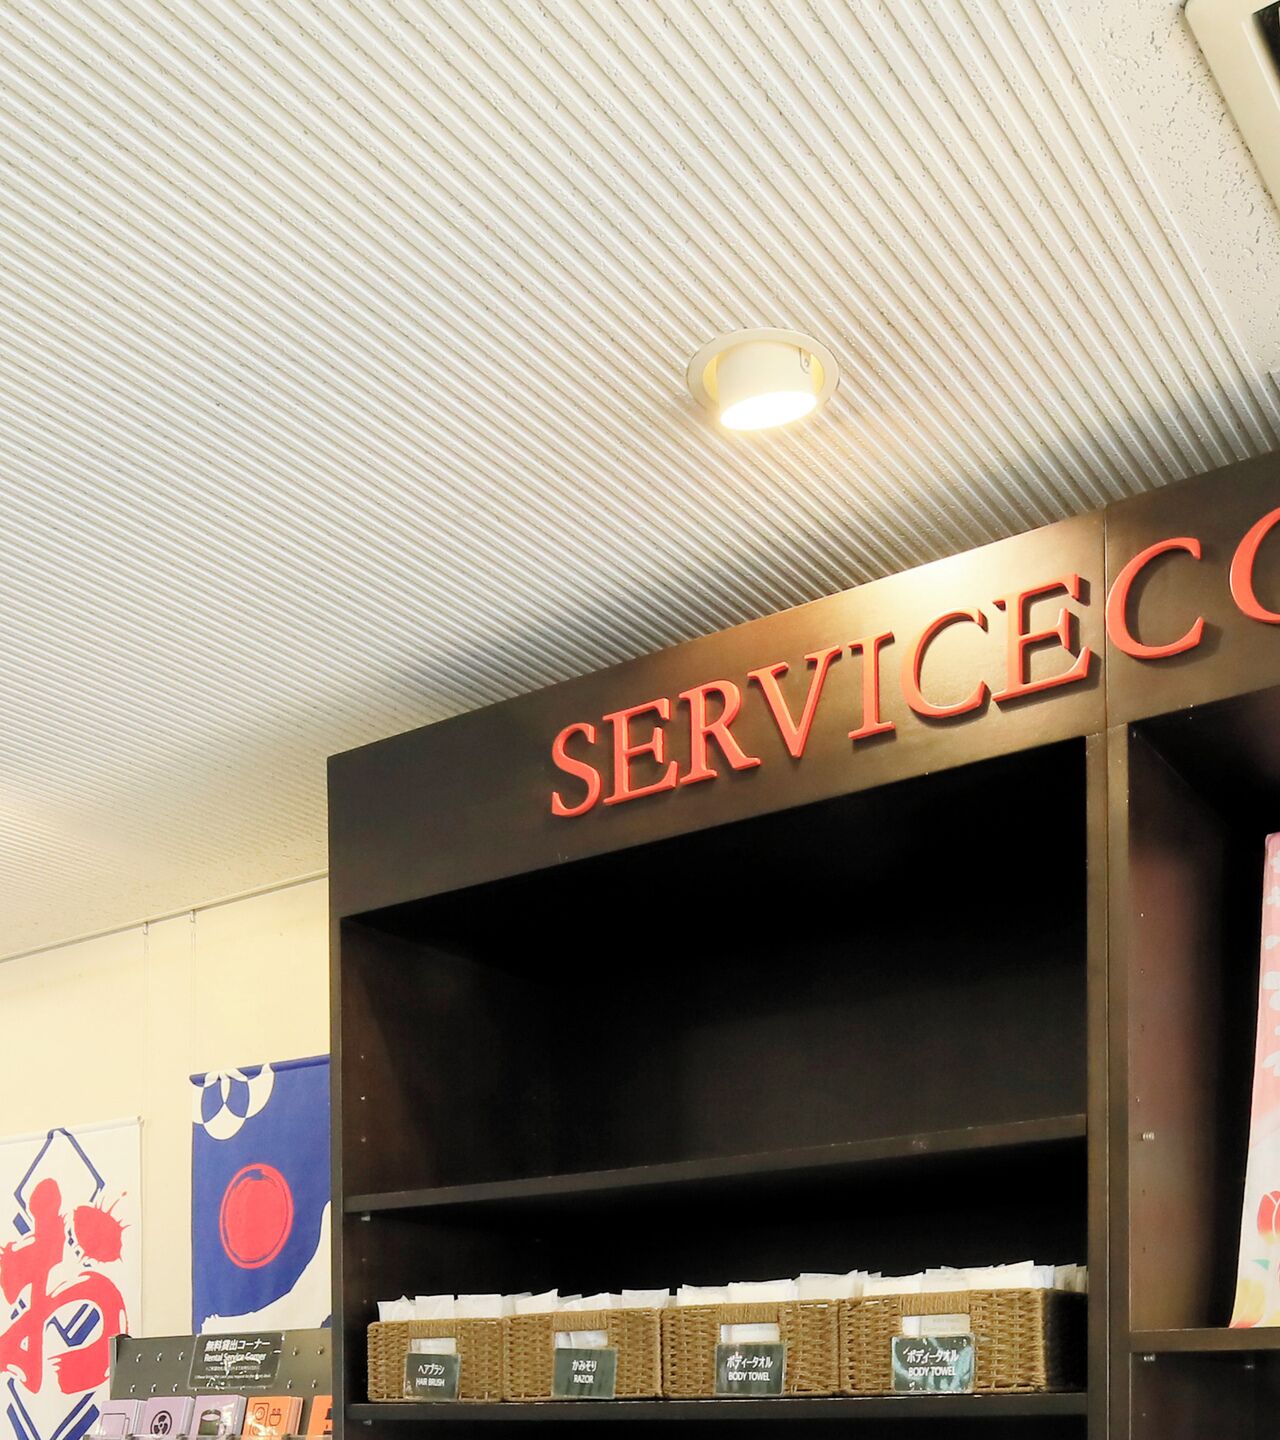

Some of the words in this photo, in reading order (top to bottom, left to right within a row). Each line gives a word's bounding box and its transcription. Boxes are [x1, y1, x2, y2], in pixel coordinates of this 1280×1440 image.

[551, 570, 1102, 817] SERVICE
[205, 1338, 270, 1352] 無料貸出コーナー
[204, 1354, 223, 1362] Rental
[726, 1352, 772, 1370] ボディータオル
[907, 1348, 960, 1364] ボディータオル
[418, 1363, 445, 1375] ヘアブラシ
[572, 1360, 597, 1373] かみそり
[908, 1366, 930, 1377] BODY
[931, 1366, 956, 1377] TOWEL
[416, 1377, 428, 1387] HAIR
[428, 1378, 445, 1388] BRUSH
[573, 1374, 594, 1384] RAZOR
[728, 1371, 747, 1382] BODY
[748, 1371, 770, 1382] TOWEL
